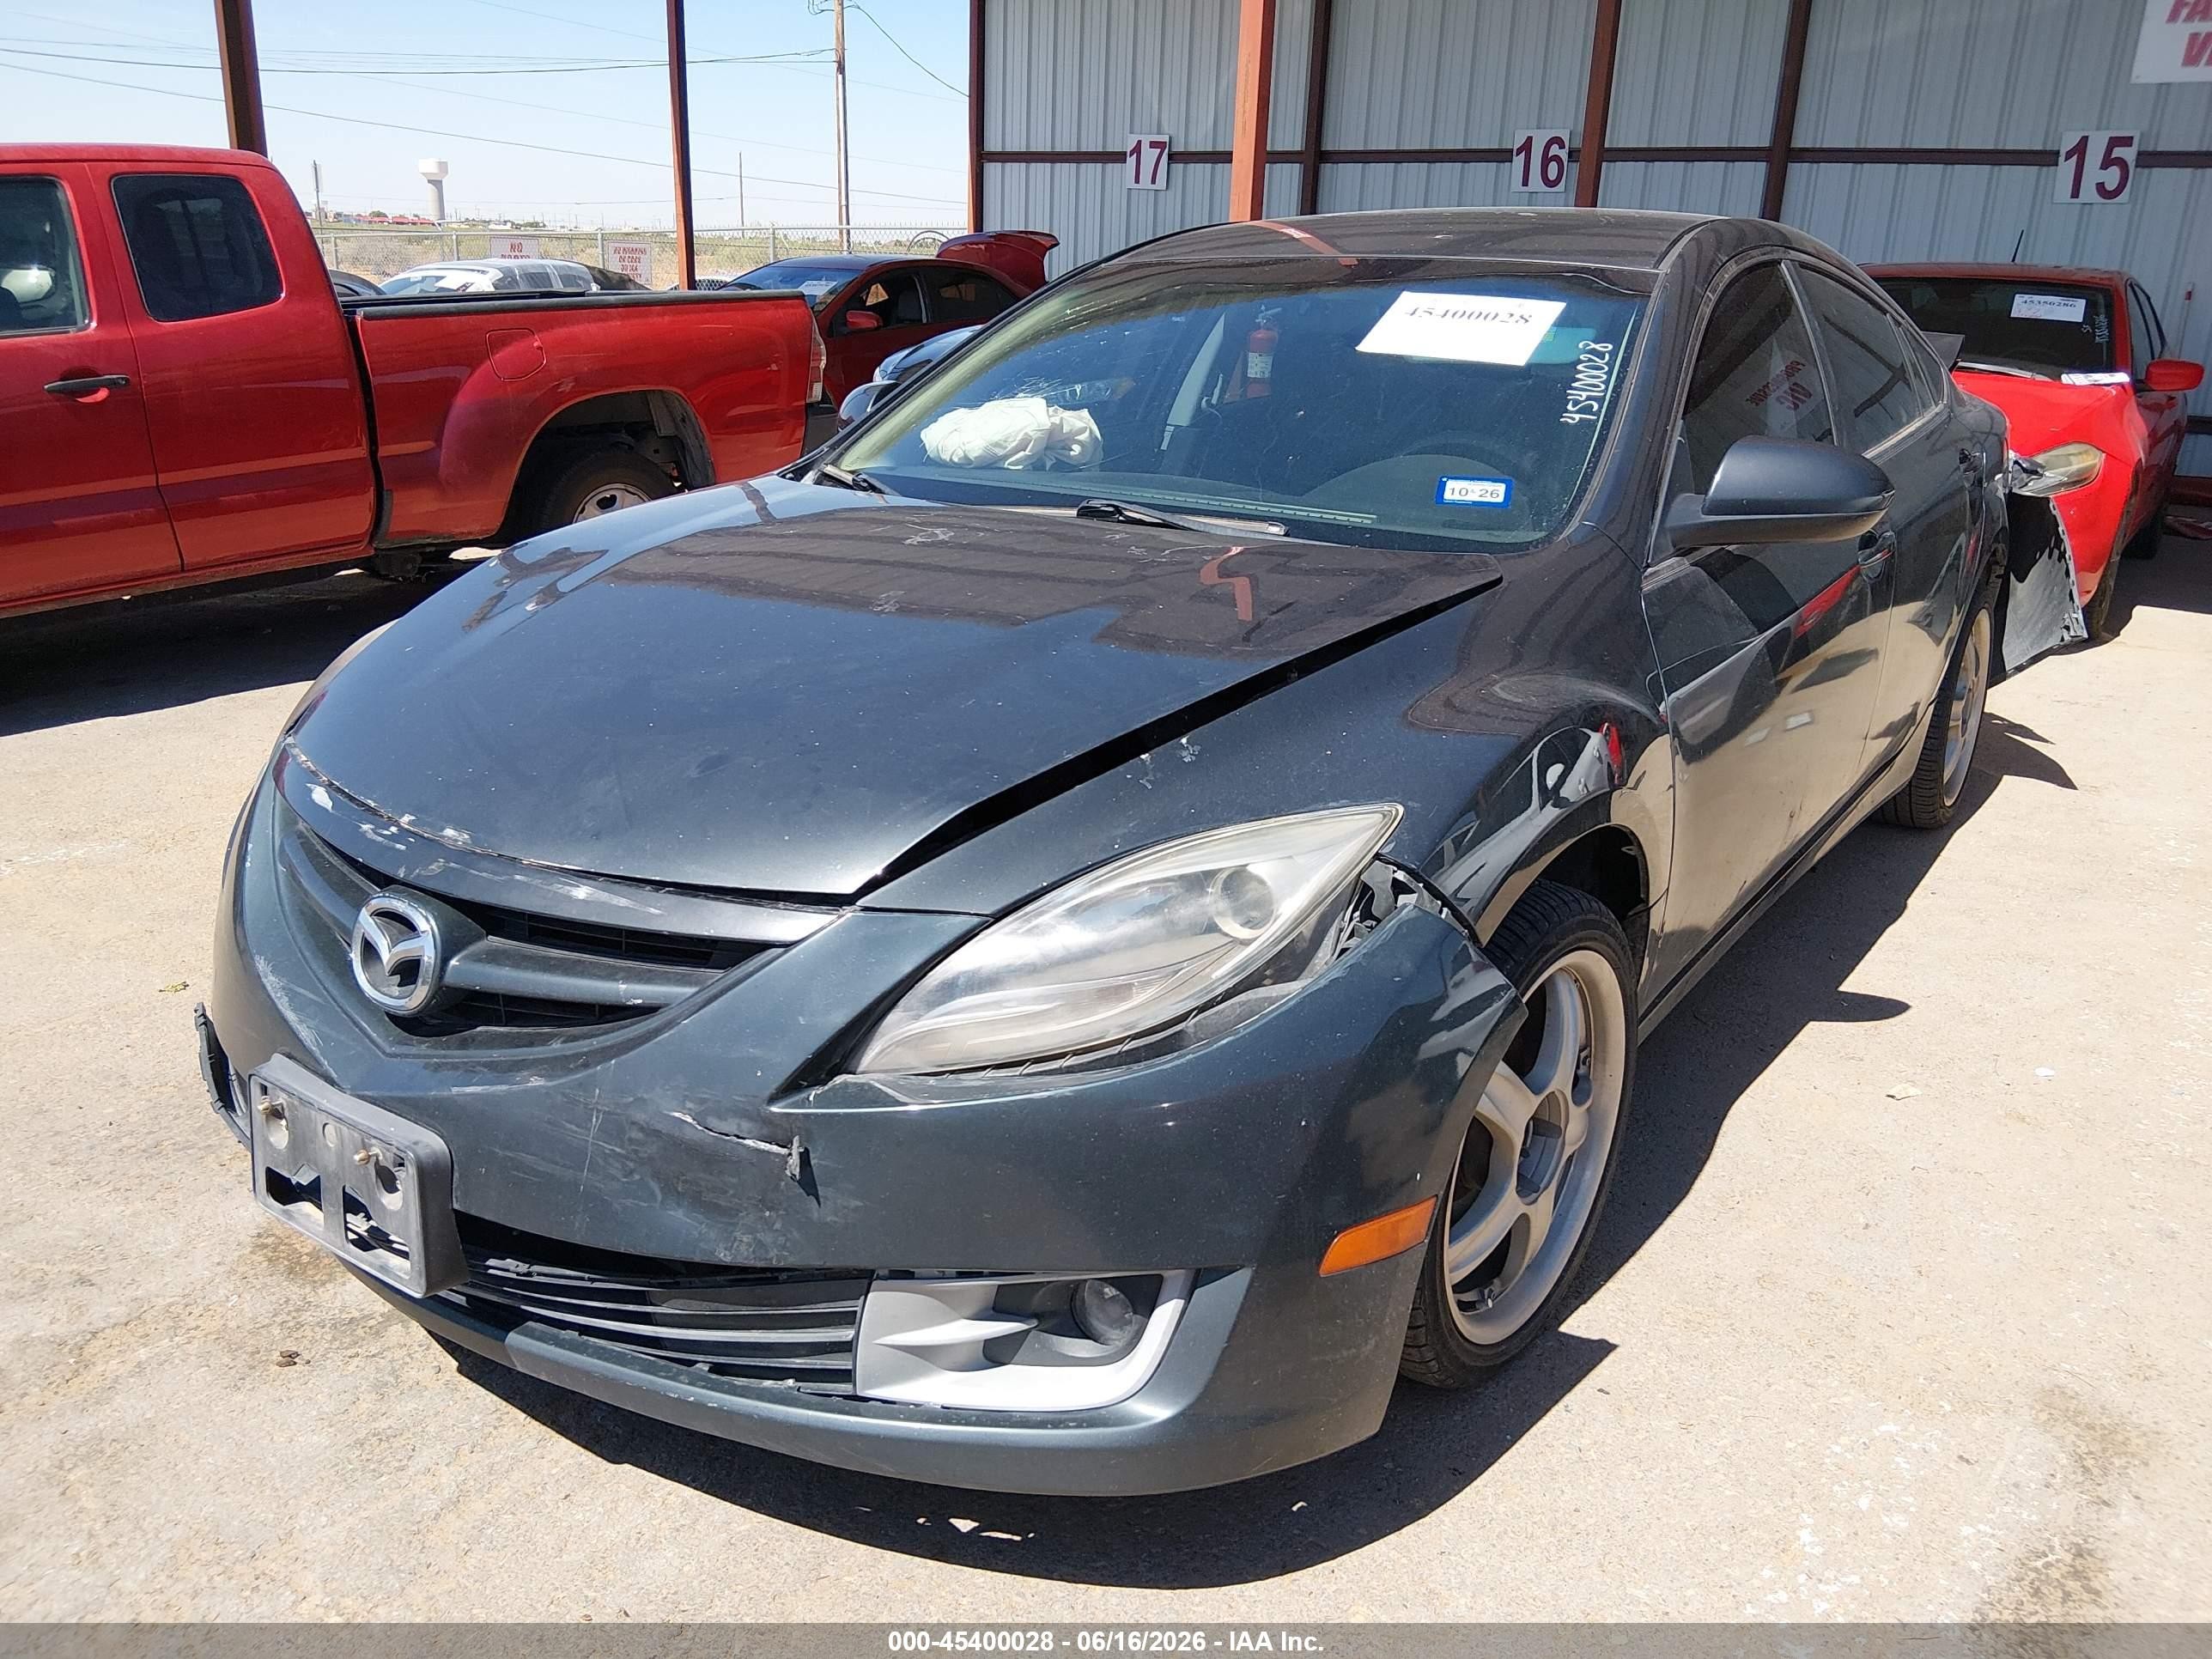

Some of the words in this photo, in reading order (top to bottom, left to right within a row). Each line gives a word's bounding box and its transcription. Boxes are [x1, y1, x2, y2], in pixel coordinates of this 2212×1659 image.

[1129, 139, 1167, 185] 17
[1516, 136, 1566, 188] 16
[2064, 135, 2134, 200] 15
[1403, 307, 1533, 325] 45400028
[1559, 340, 1613, 423] 45400028
